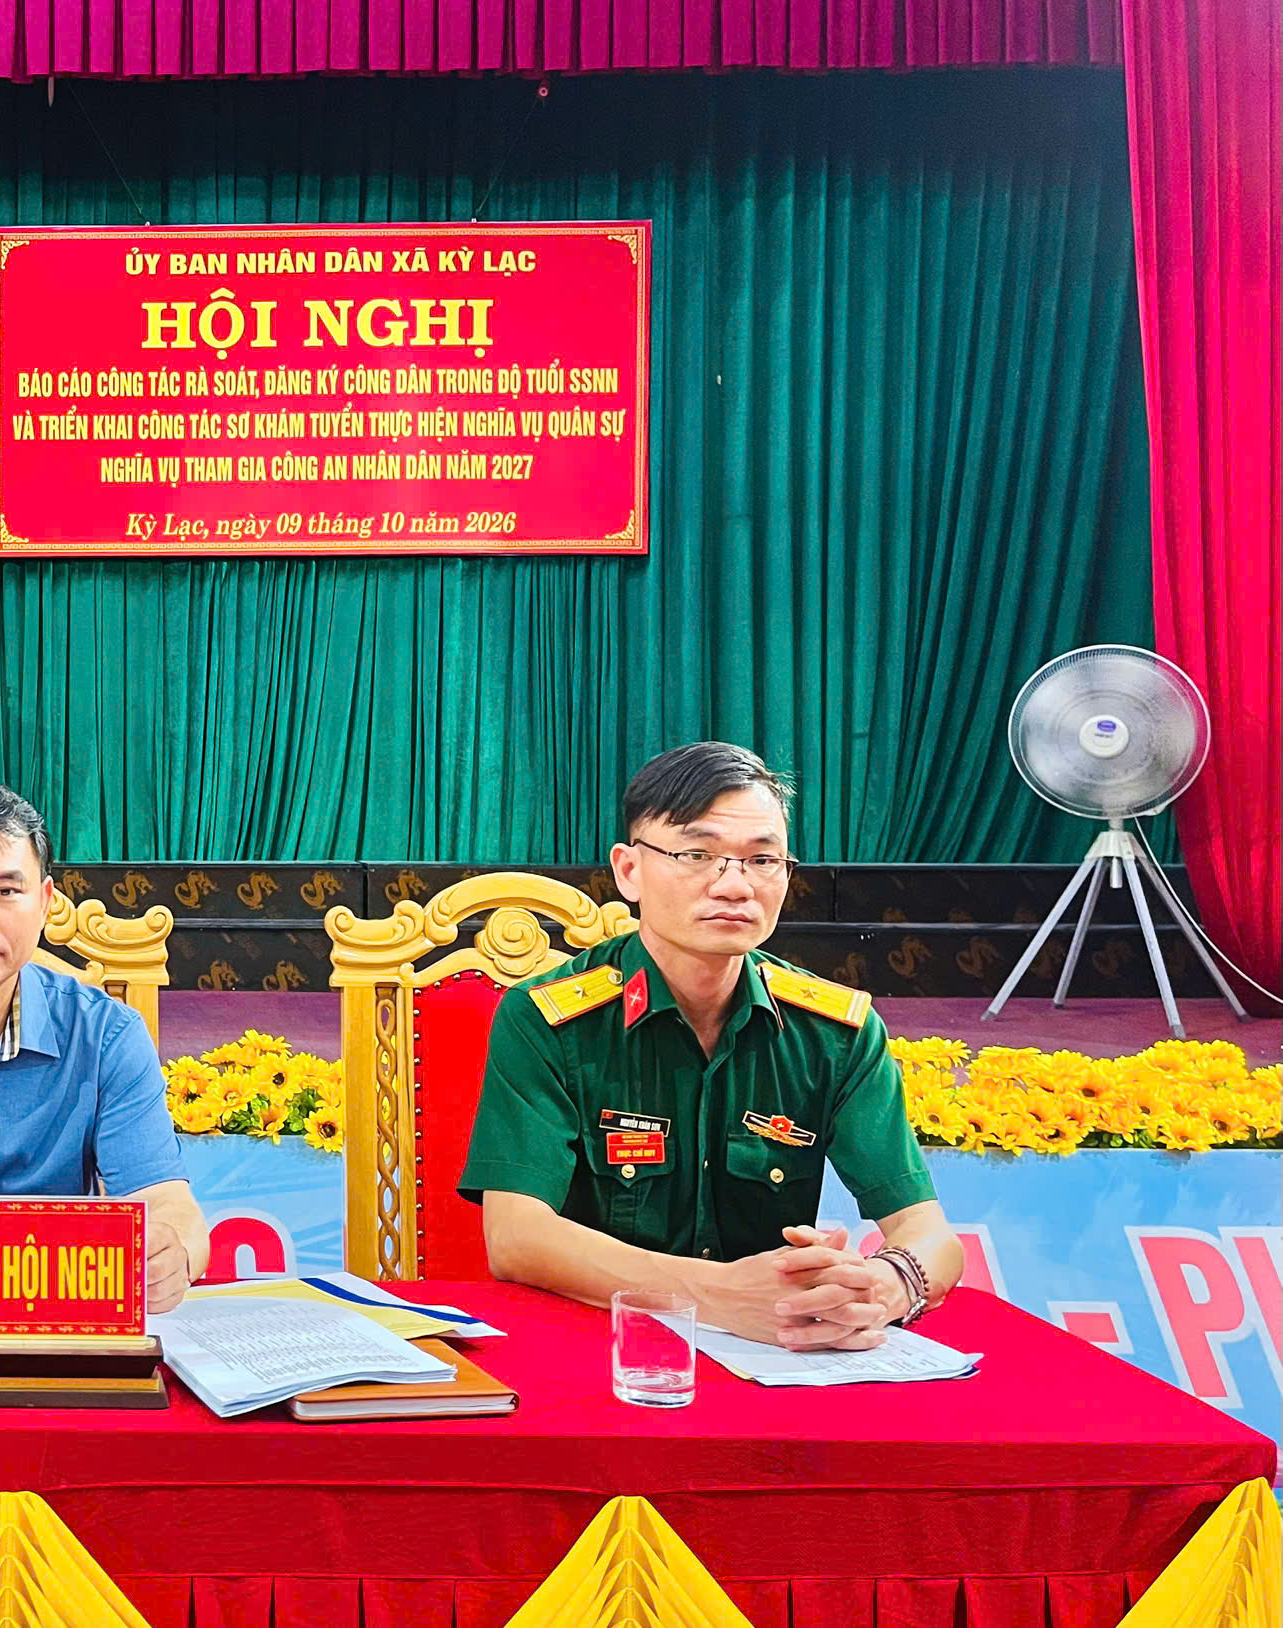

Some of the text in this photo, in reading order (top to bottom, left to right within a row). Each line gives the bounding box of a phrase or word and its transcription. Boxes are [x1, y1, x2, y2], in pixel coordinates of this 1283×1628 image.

[126, 247, 535, 276] ỦY BAN NHÂN DÂN XÃ KỲ LẠC
[141, 288, 493, 360] HỘI NGHỊ
[19, 360, 617, 399] BÁO CÁO CÔNG TÁC RÀ SOÁT, ĐĂNG KÝ CÔNG DÂN TRONG ĐỘ TUỔI SSNN
[13, 402, 626, 442] VÀ TRIỂN KHAI CÔNG TÁC SƠ KHÁM TUYỂN THỰC HIỆN NGHĨA VỤ QUÂN SỰ
[101, 450, 533, 488] NGHĨA VỤ THAM GIA CÔNG AN NHÂN DÂN NĂM 2027
[125, 512, 516, 541] Kỳ Lạc, ngày 09 tháng 10 năm 2026
[3, 1234, 48, 1311] HỘI
[58, 1246, 124, 1312] NGHỊ
